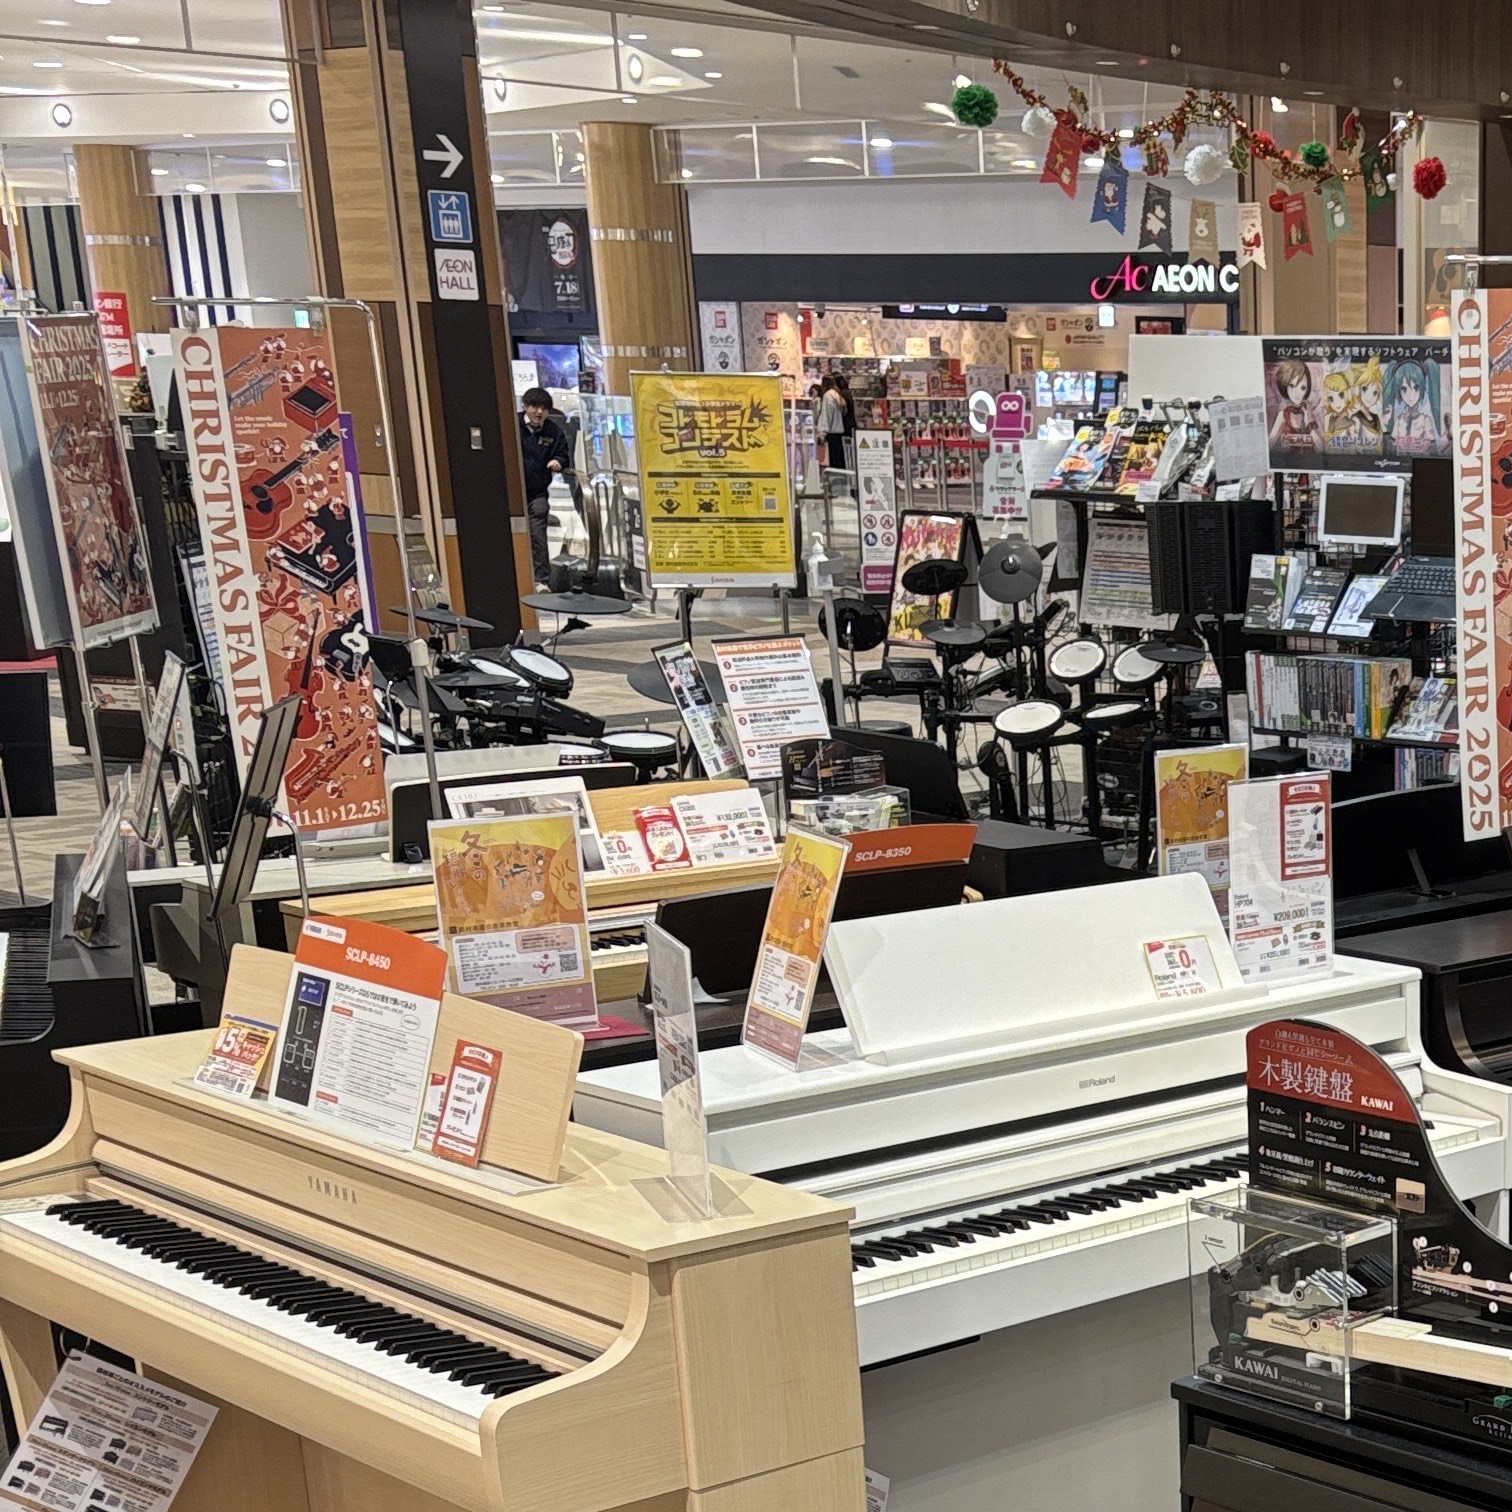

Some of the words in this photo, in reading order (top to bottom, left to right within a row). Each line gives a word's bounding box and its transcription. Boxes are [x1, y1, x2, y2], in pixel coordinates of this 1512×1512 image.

[439, 276, 476, 291] HALL
[1151, 264, 1215, 293] AEON
[31, 323, 98, 354] CHRISTMAS
[33, 356, 65, 385] FAIR
[659, 428, 765, 453] コンテスト
[1457, 298, 1487, 595] CHRISTMAS
[179, 335, 252, 621] CHRISTMAS
[1460, 602, 1490, 719] FAIR
[222, 622, 264, 730] FAIR
[1465, 727, 1495, 833] 2025
[294, 809, 324, 827] 11.1
[338, 800, 380, 821] 12.25
[854, 845, 912, 862] SCLP-8350
[344, 946, 391, 971] SCLP-8450
[1154, 971, 1178, 982] Roland
[1089, 1074, 1116, 1088] Roland
[1258, 1054, 1354, 1104] 木製鍵盤
[1360, 1095, 1394, 1112] KAWAI
[307, 1175, 359, 1206] YAMAHA
[1234, 1355, 1279, 1380] KAWAI
